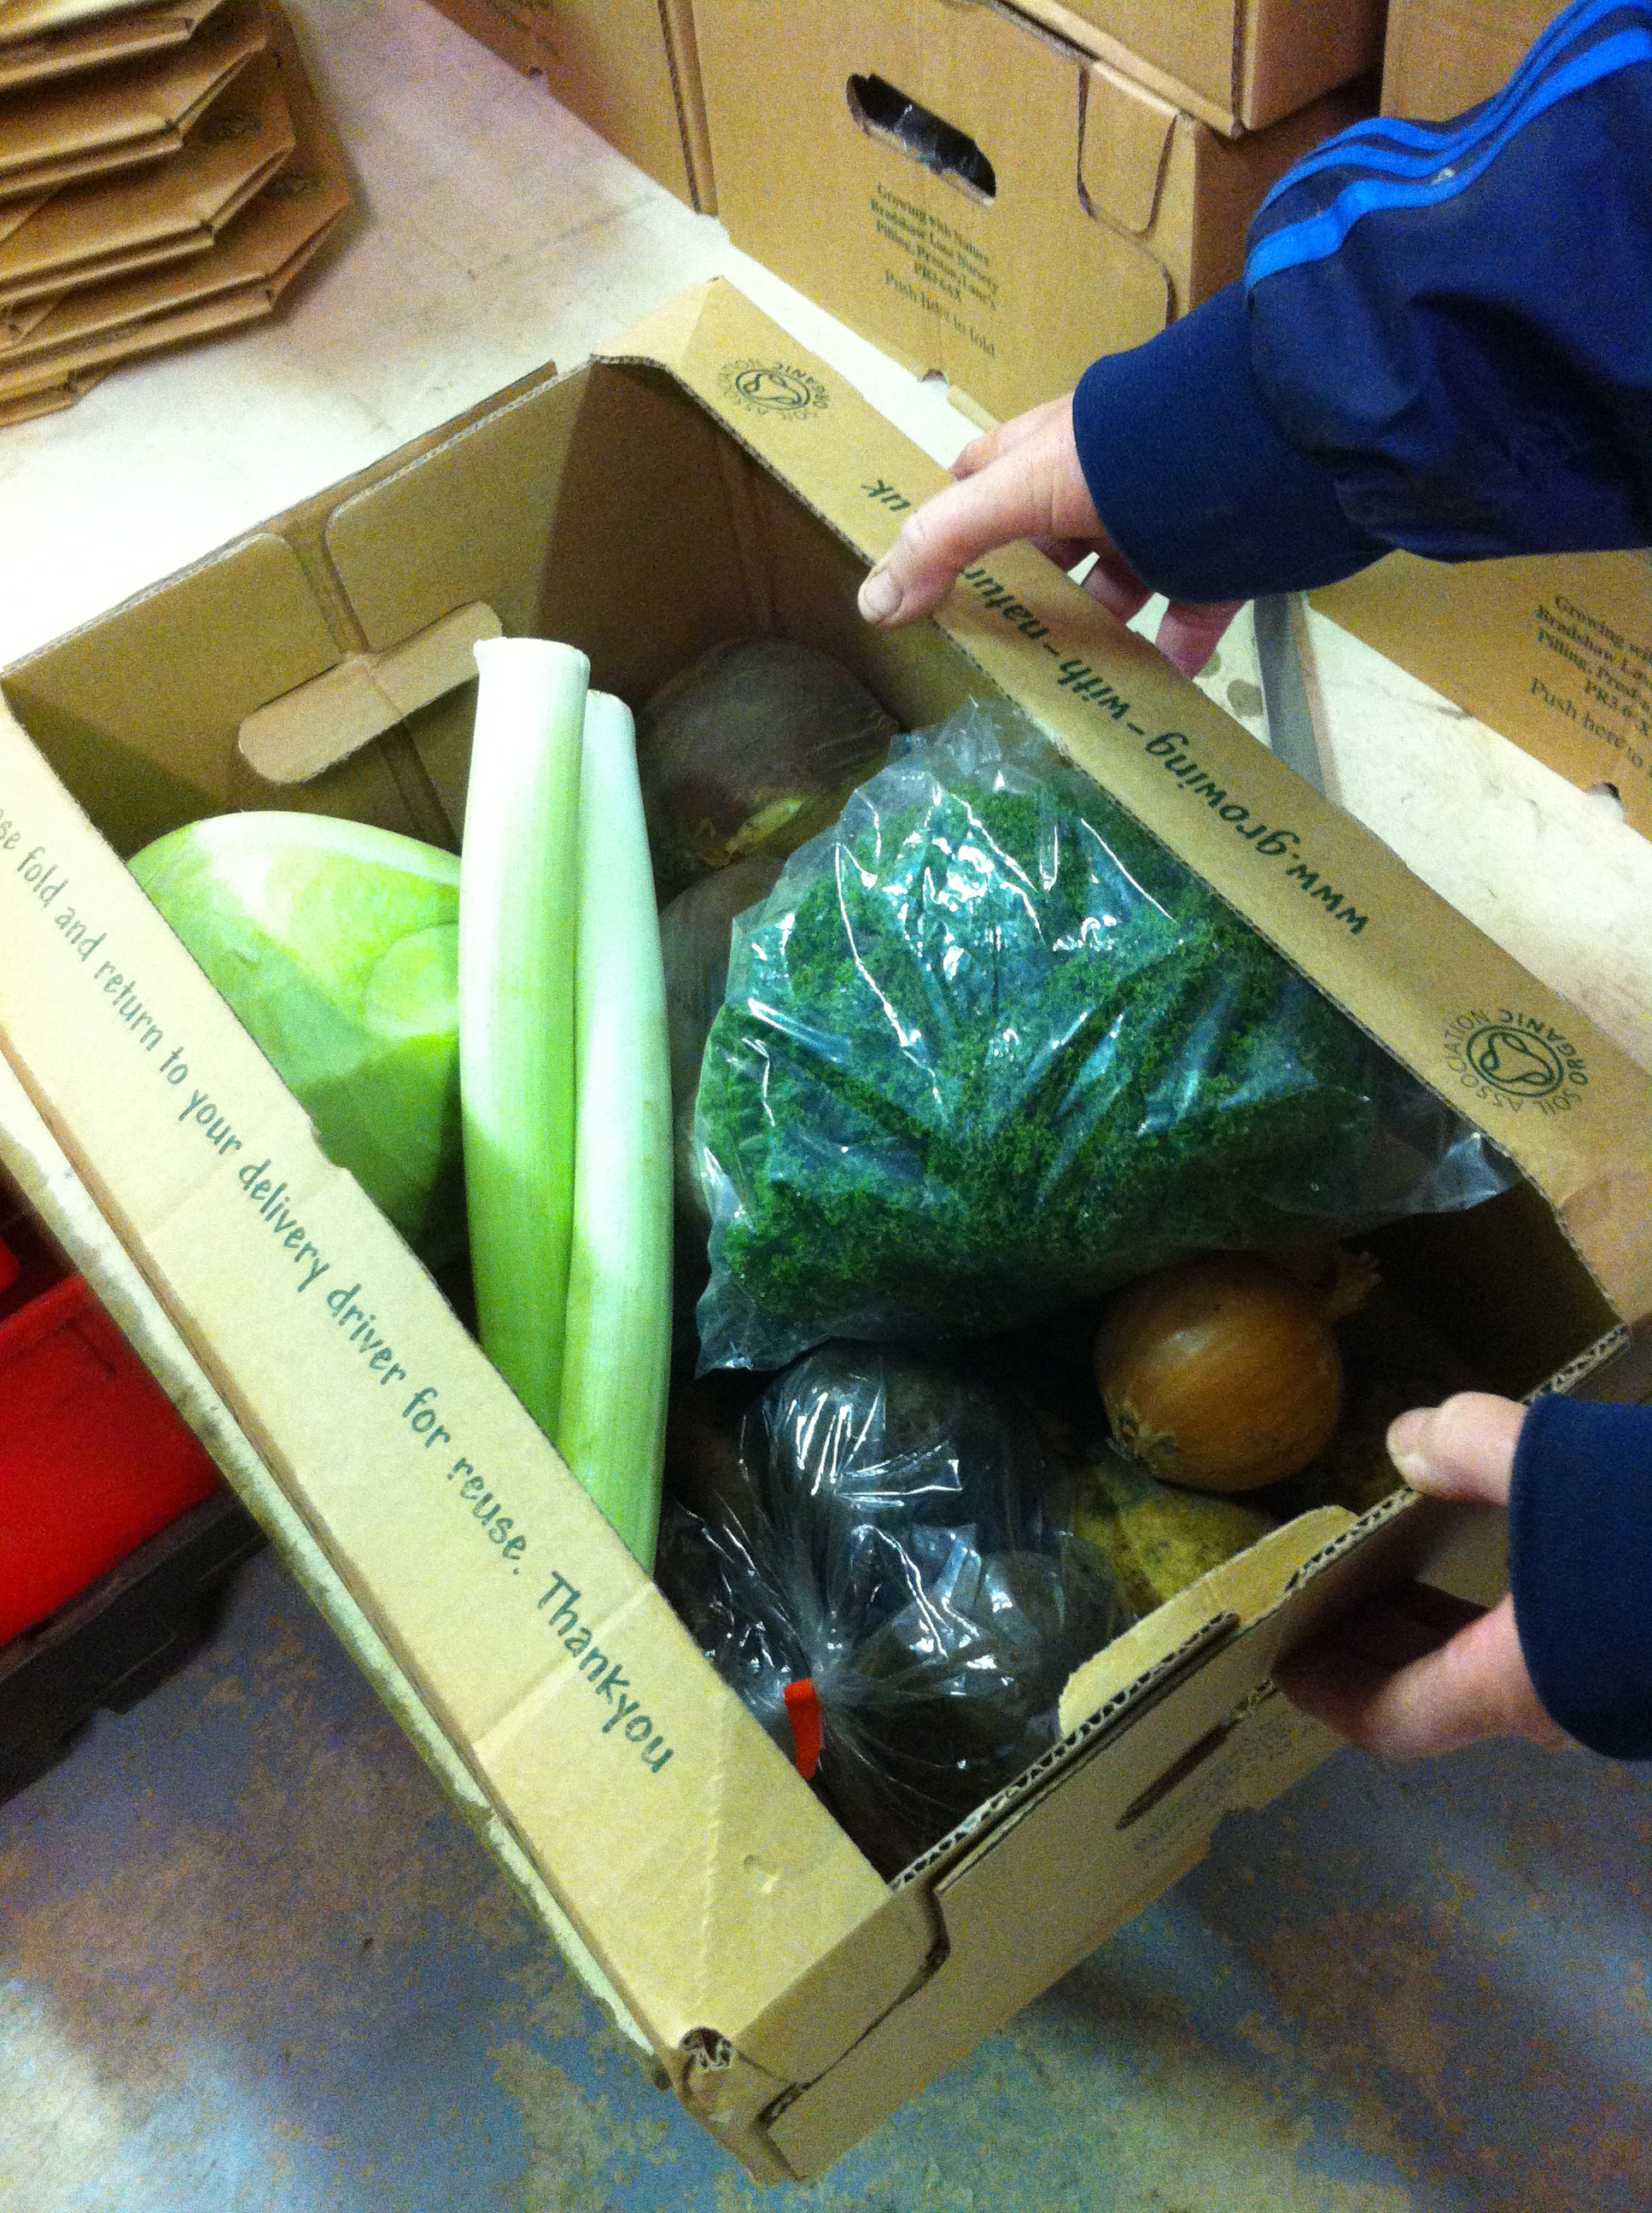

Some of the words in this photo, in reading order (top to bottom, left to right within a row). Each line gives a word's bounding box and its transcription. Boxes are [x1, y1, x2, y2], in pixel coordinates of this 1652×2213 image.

[1530, 678, 1576, 721] Push
[1582, 709, 1626, 750] here
[1626, 746, 1643, 768] to
[1443, 1009, 1526, 1113] ASSOCIATION
[1497, 1007, 1589, 1087] ORGANIC
[1532, 1087, 1582, 1116] SOIL
[17, 846, 68, 908] fold
[55, 906, 108, 963] and
[94, 959, 165, 1053] return
[160, 1047, 190, 1086] to
[179, 1089, 243, 1156] your
[238, 1159, 330, 1293] delivery
[327, 1283, 406, 1386] driver
[402, 1387, 452, 1449] for
[447, 1457, 527, 1576] reuse.
[537, 1570, 675, 1774] Thankyou
